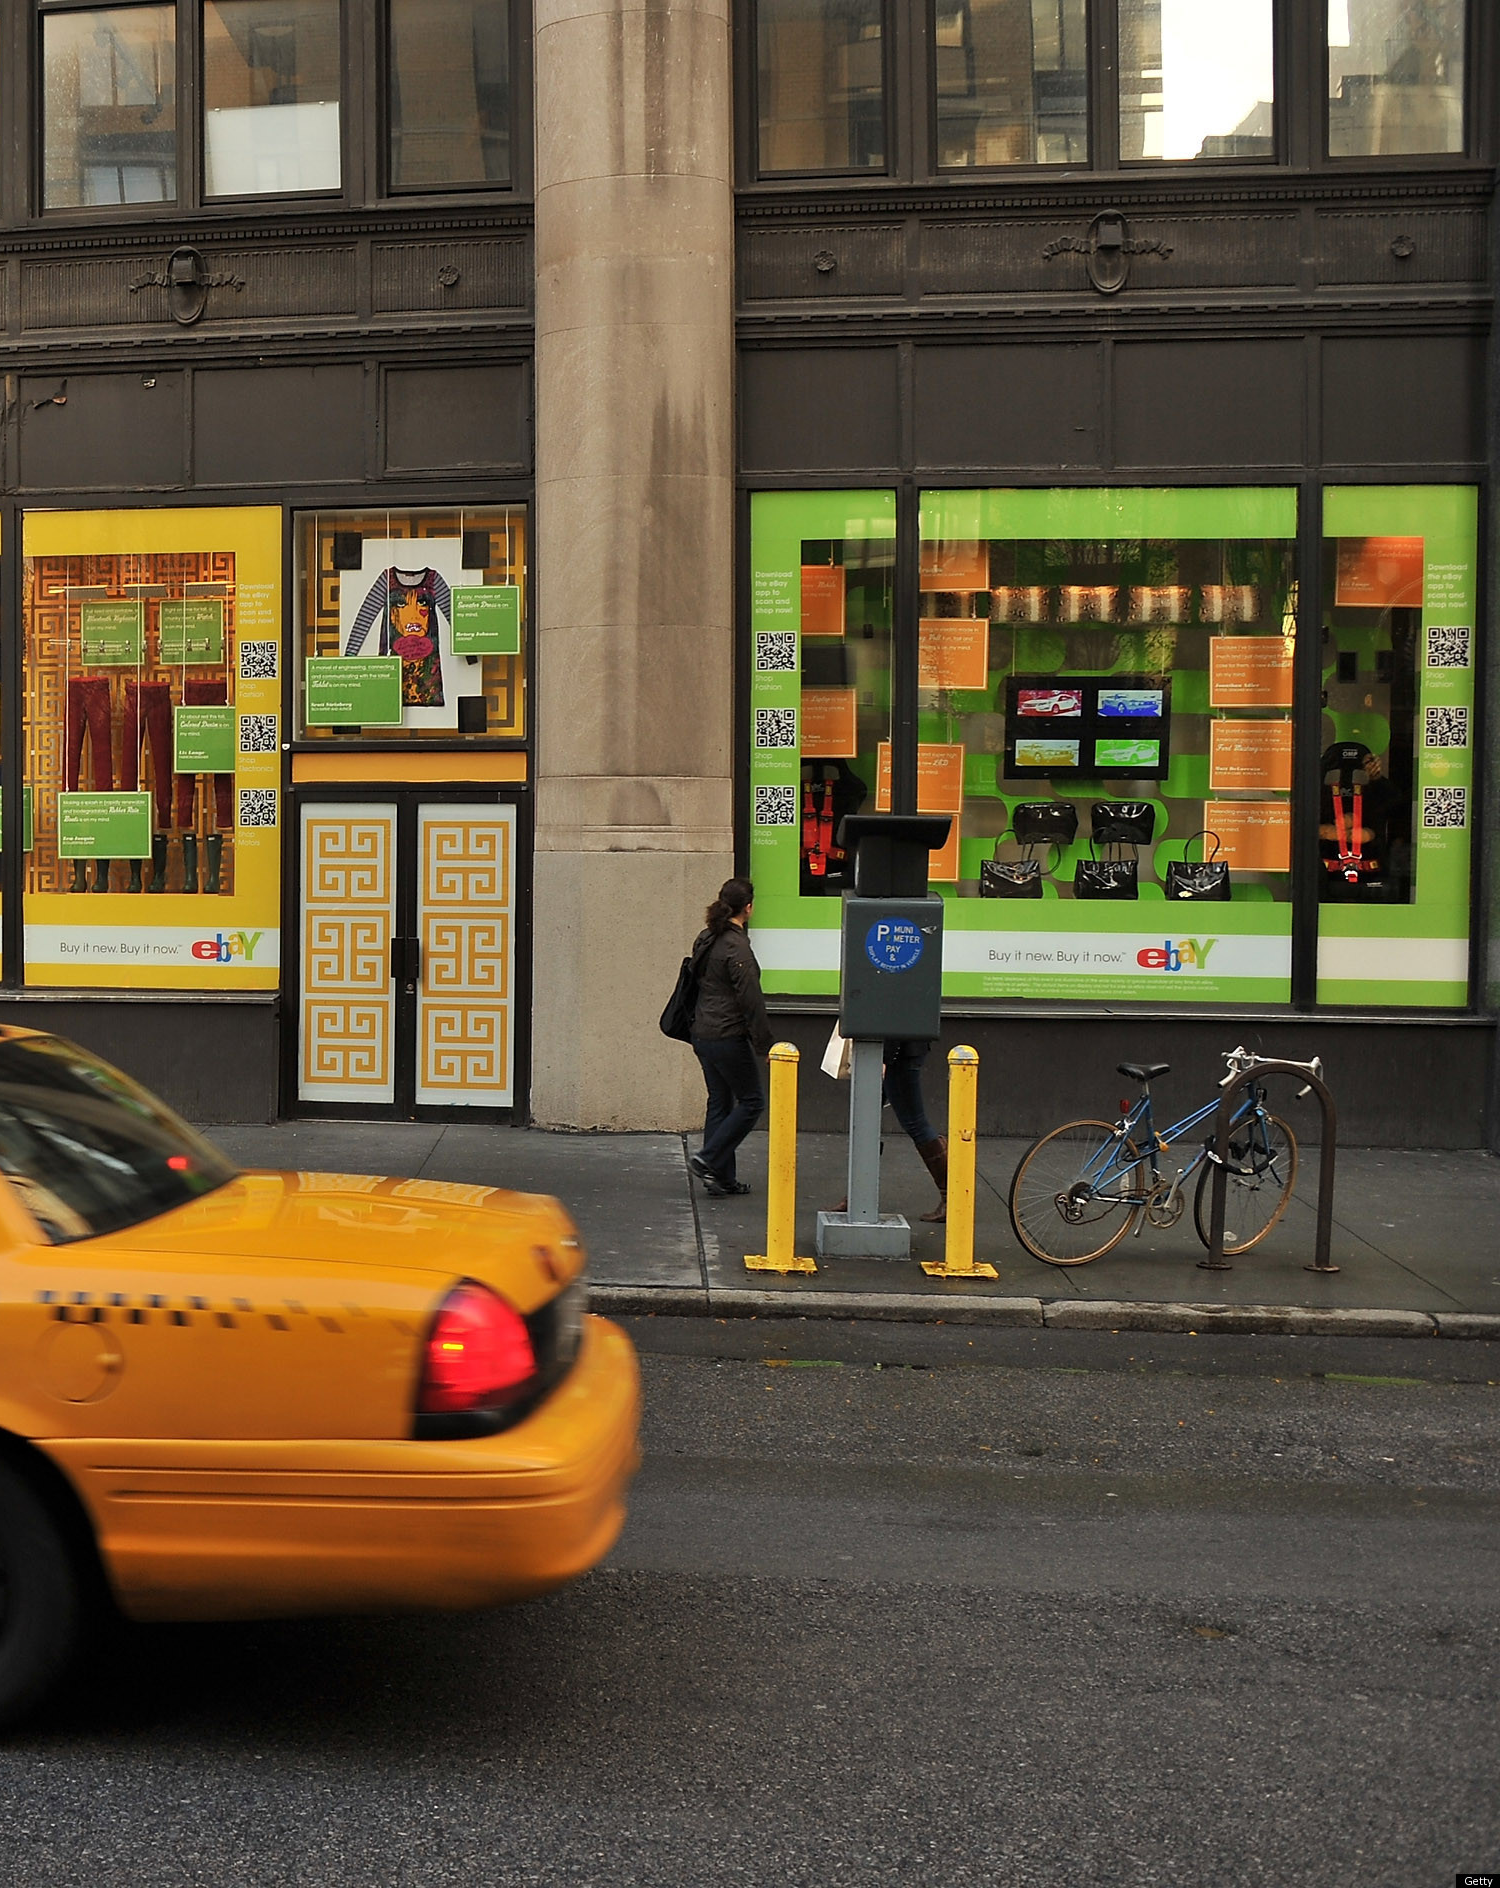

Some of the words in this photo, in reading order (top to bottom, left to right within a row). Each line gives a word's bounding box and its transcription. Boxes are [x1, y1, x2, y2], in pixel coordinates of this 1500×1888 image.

[1442, 573, 1462, 581] eBay
[769, 580, 788, 588] eBay
[877, 924, 890, 942] P
[894, 925, 914, 934] MUNI
[893, 935, 920, 944] METER
[60, 942, 81, 955] Buy
[82, 942, 90, 953] it
[93, 945, 118, 953] new.
[120, 943, 141, 956] Buy
[143, 943, 150, 954] it
[885, 945, 901, 953] PAY
[889, 953, 896, 962] &
[988, 949, 1011, 962] Buy
[1014, 949, 1022, 961] it
[1025, 952, 1054, 962] new.
[1057, 950, 1080, 963] Buy
[1082, 950, 1090, 962] it
